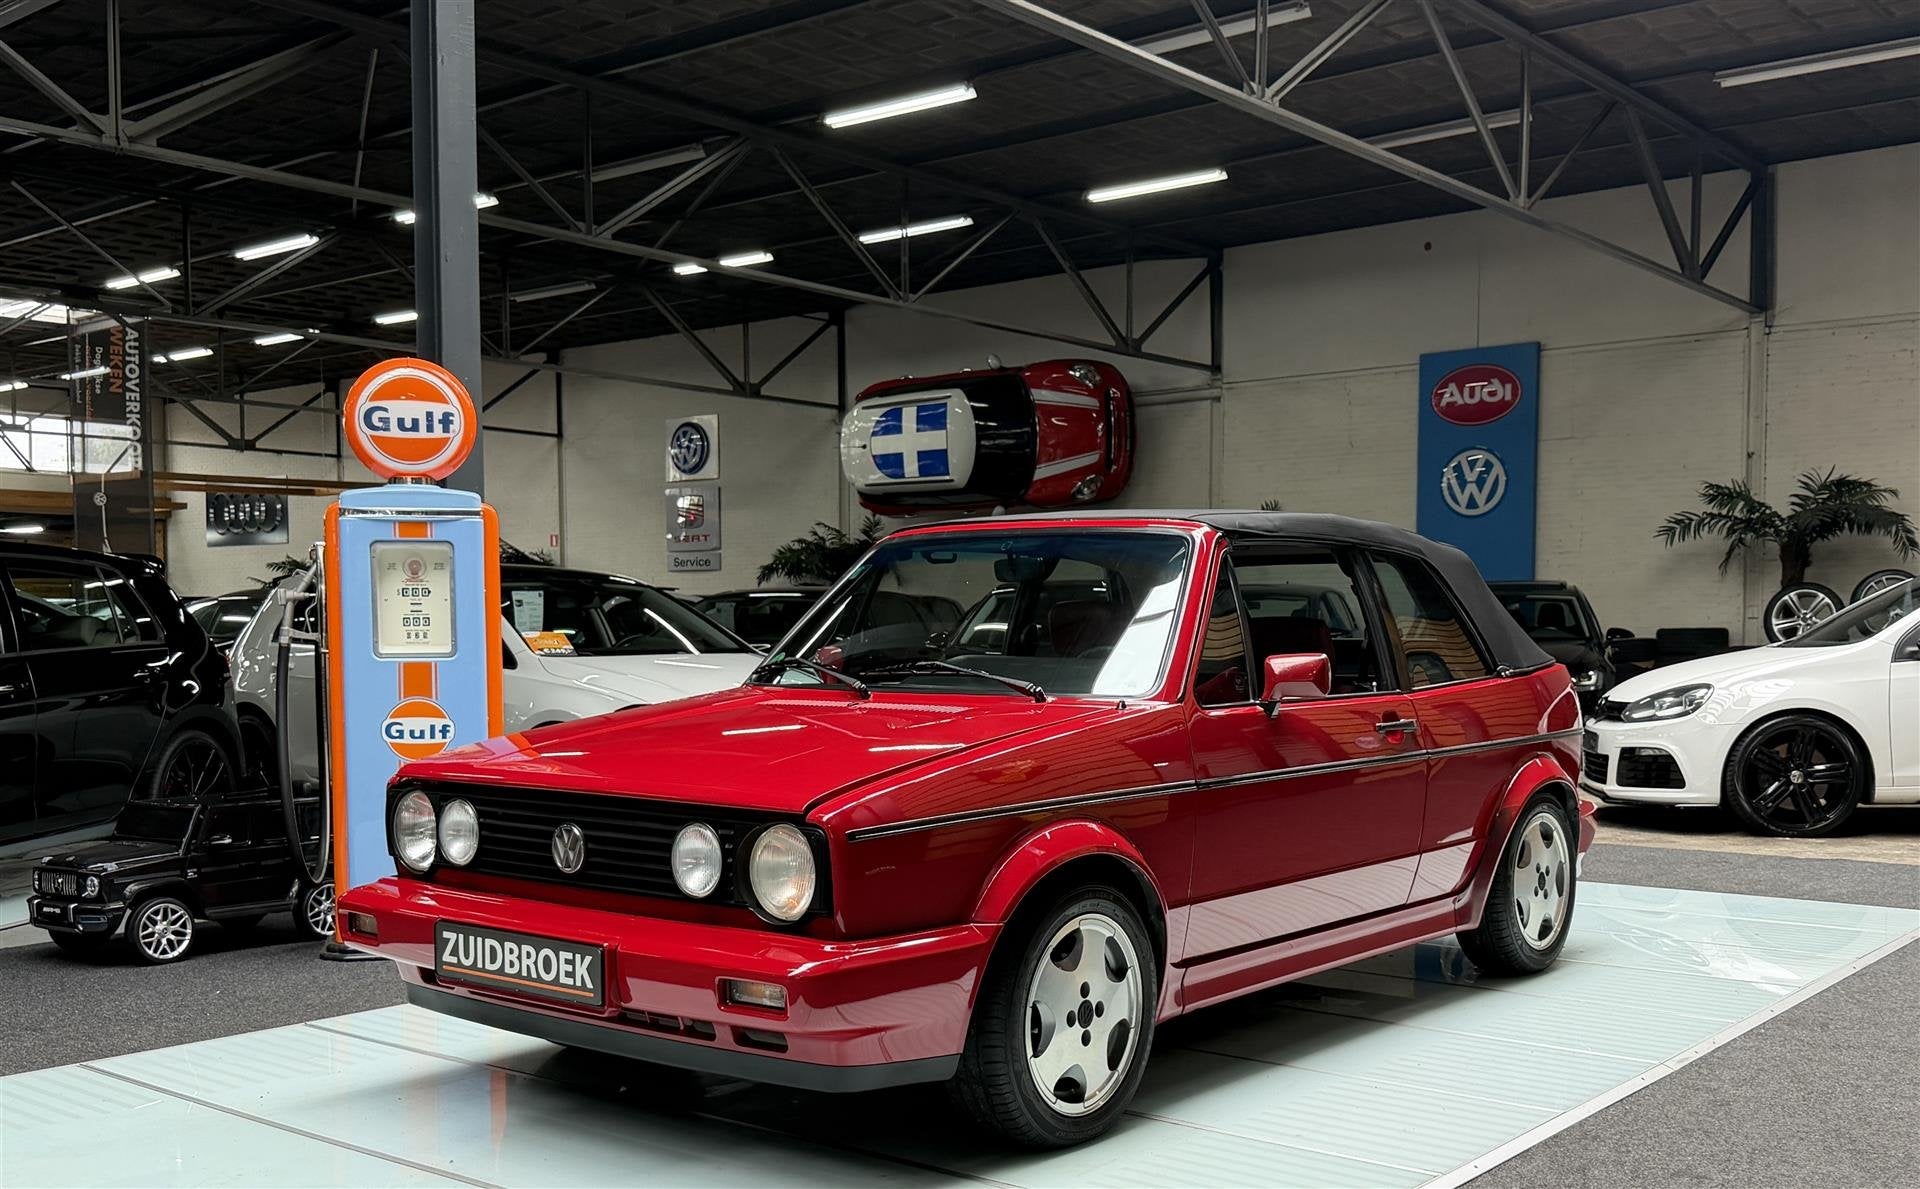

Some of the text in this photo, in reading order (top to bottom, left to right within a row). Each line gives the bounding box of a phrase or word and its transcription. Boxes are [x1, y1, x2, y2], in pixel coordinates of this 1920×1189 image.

[109, 326, 123, 393] WEKEN
[363, 405, 455, 434] Gulf
[674, 556, 711, 567] Service
[384, 721, 451, 740] Gulf
[442, 931, 594, 989] ZUIDBROEK
